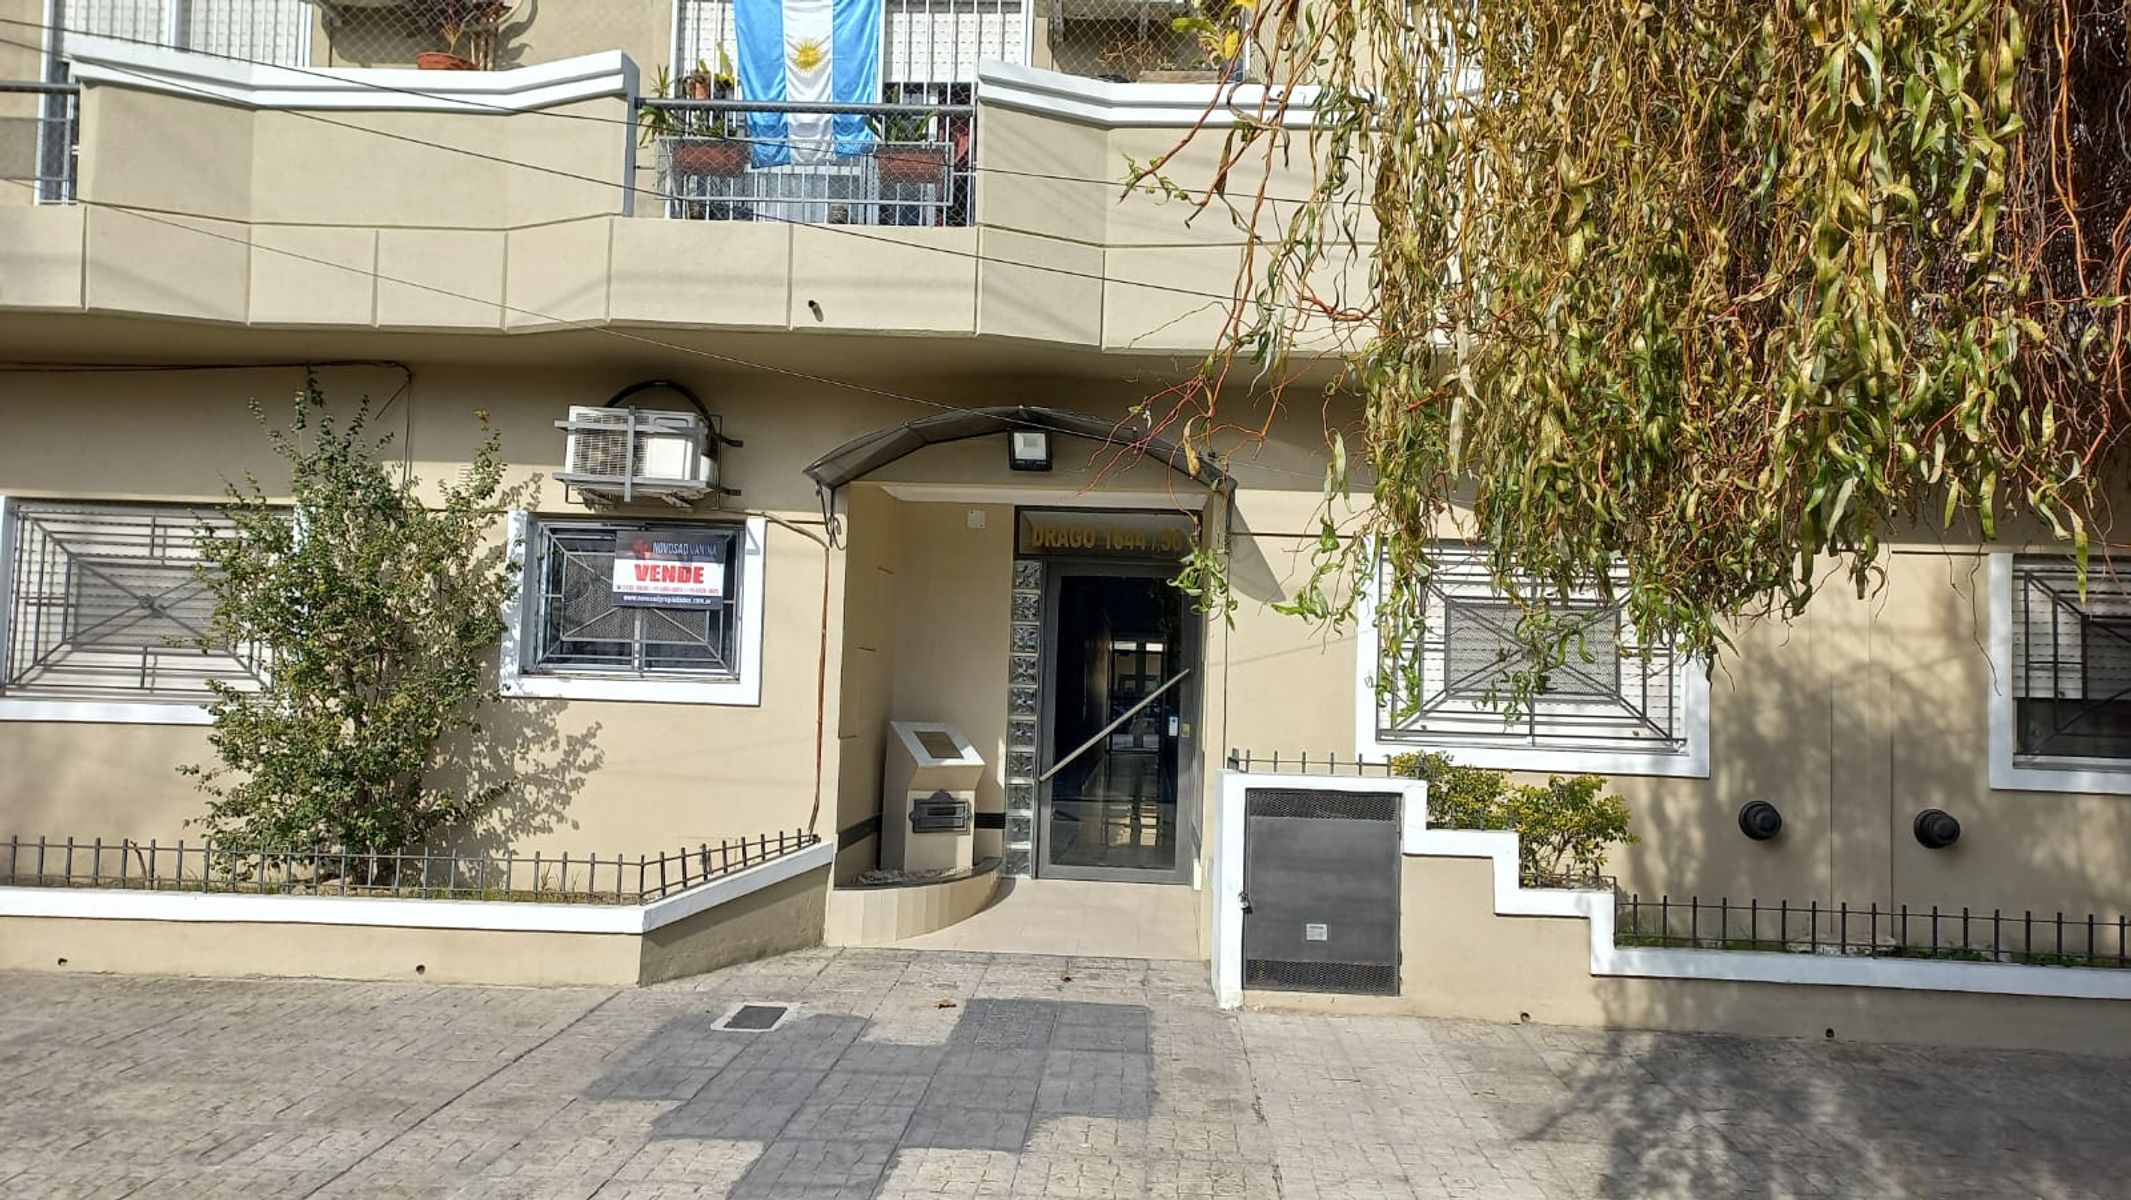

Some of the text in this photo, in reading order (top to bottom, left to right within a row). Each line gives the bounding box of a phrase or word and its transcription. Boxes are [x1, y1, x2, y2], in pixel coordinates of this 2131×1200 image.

[1031, 524, 1096, 549] DRAGO
[653, 542, 717, 556] NOVOSAD VANINA
[634, 564, 704, 584] VENDE
